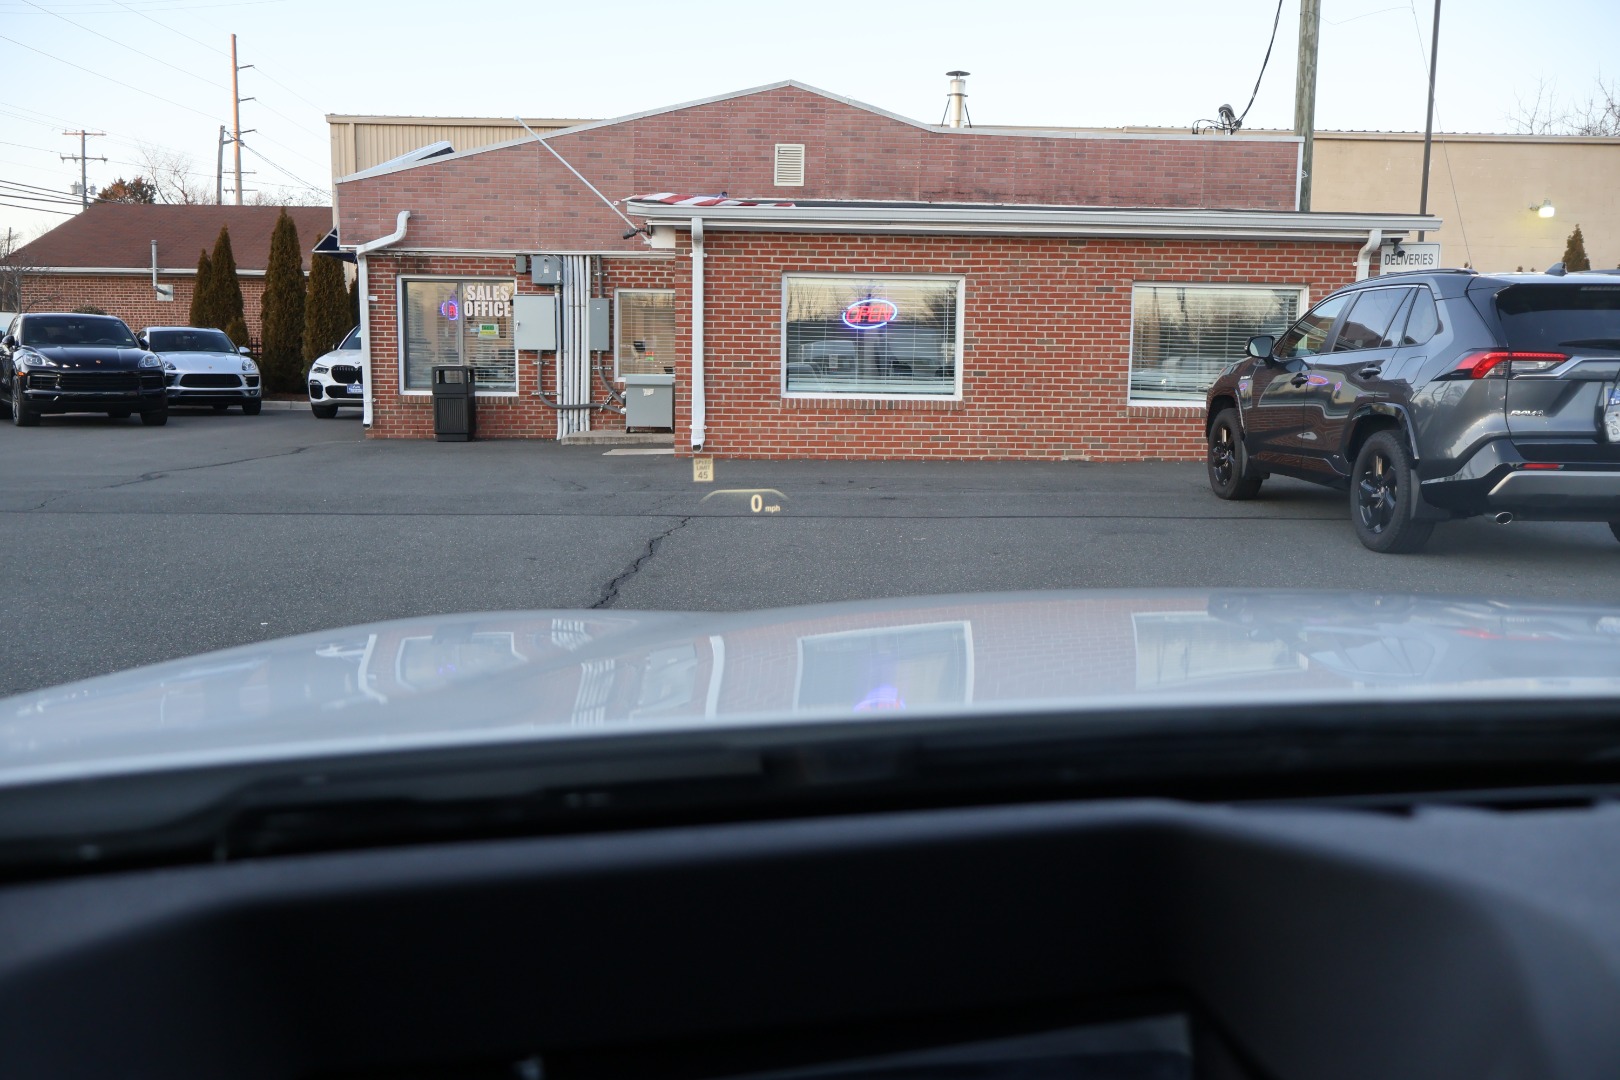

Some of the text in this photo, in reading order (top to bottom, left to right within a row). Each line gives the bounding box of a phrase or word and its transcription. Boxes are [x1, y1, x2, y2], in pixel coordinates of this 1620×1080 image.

[1384, 253, 1434, 266] DELIVERIES
[467, 285, 510, 301] SALES
[463, 301, 512, 317] OFFICE
[846, 305, 893, 323] OPEN
[697, 471, 709, 479] 45
[750, 494, 781, 514] 0 mph
